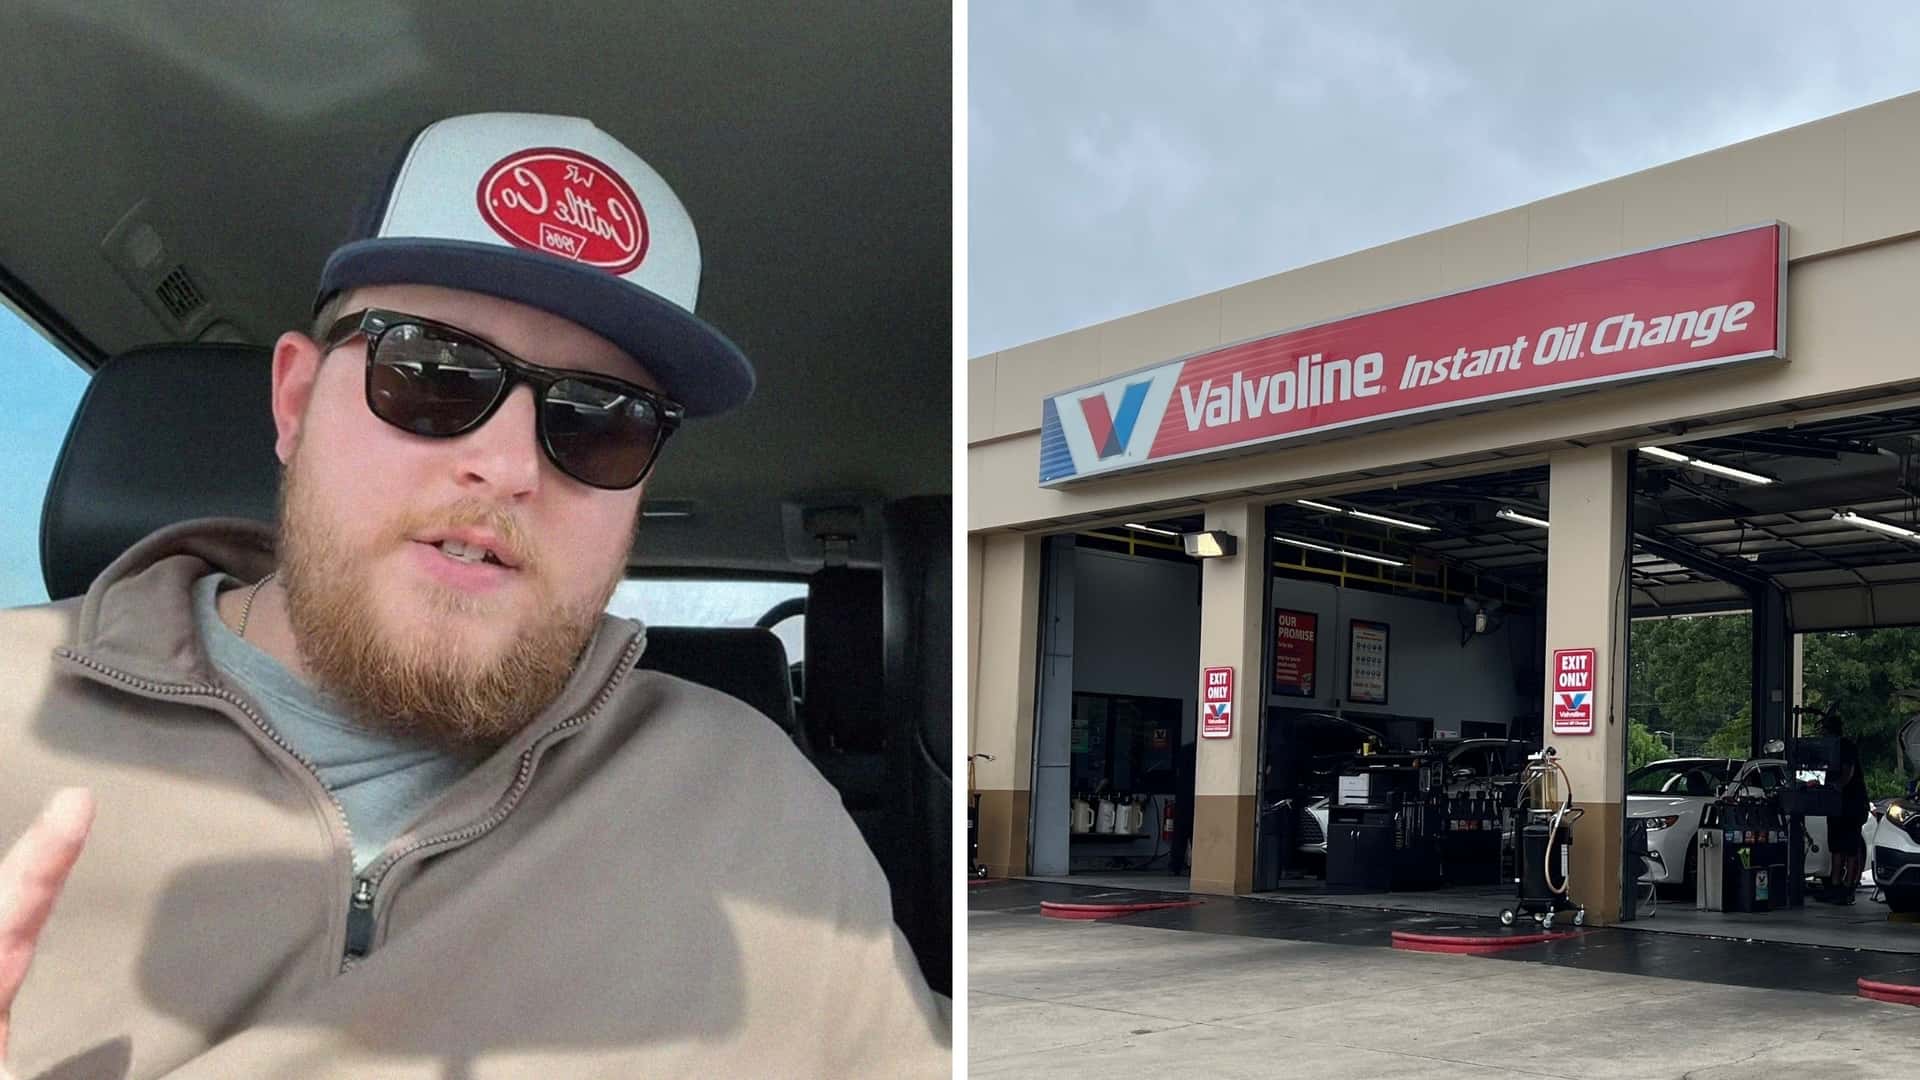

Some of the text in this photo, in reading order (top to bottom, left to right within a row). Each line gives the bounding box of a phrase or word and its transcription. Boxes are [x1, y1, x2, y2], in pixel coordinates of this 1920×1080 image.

[1179, 299, 1756, 432] Valvoline Instant Oil Change
[1279, 615, 1297, 627] OUR
[1278, 626, 1315, 641] PROMISE
[1562, 655, 1587, 670] EXIT
[1209, 672, 1228, 685] EXIT
[1559, 672, 1588, 687] ONLY
[1207, 686, 1229, 699] ONLY
